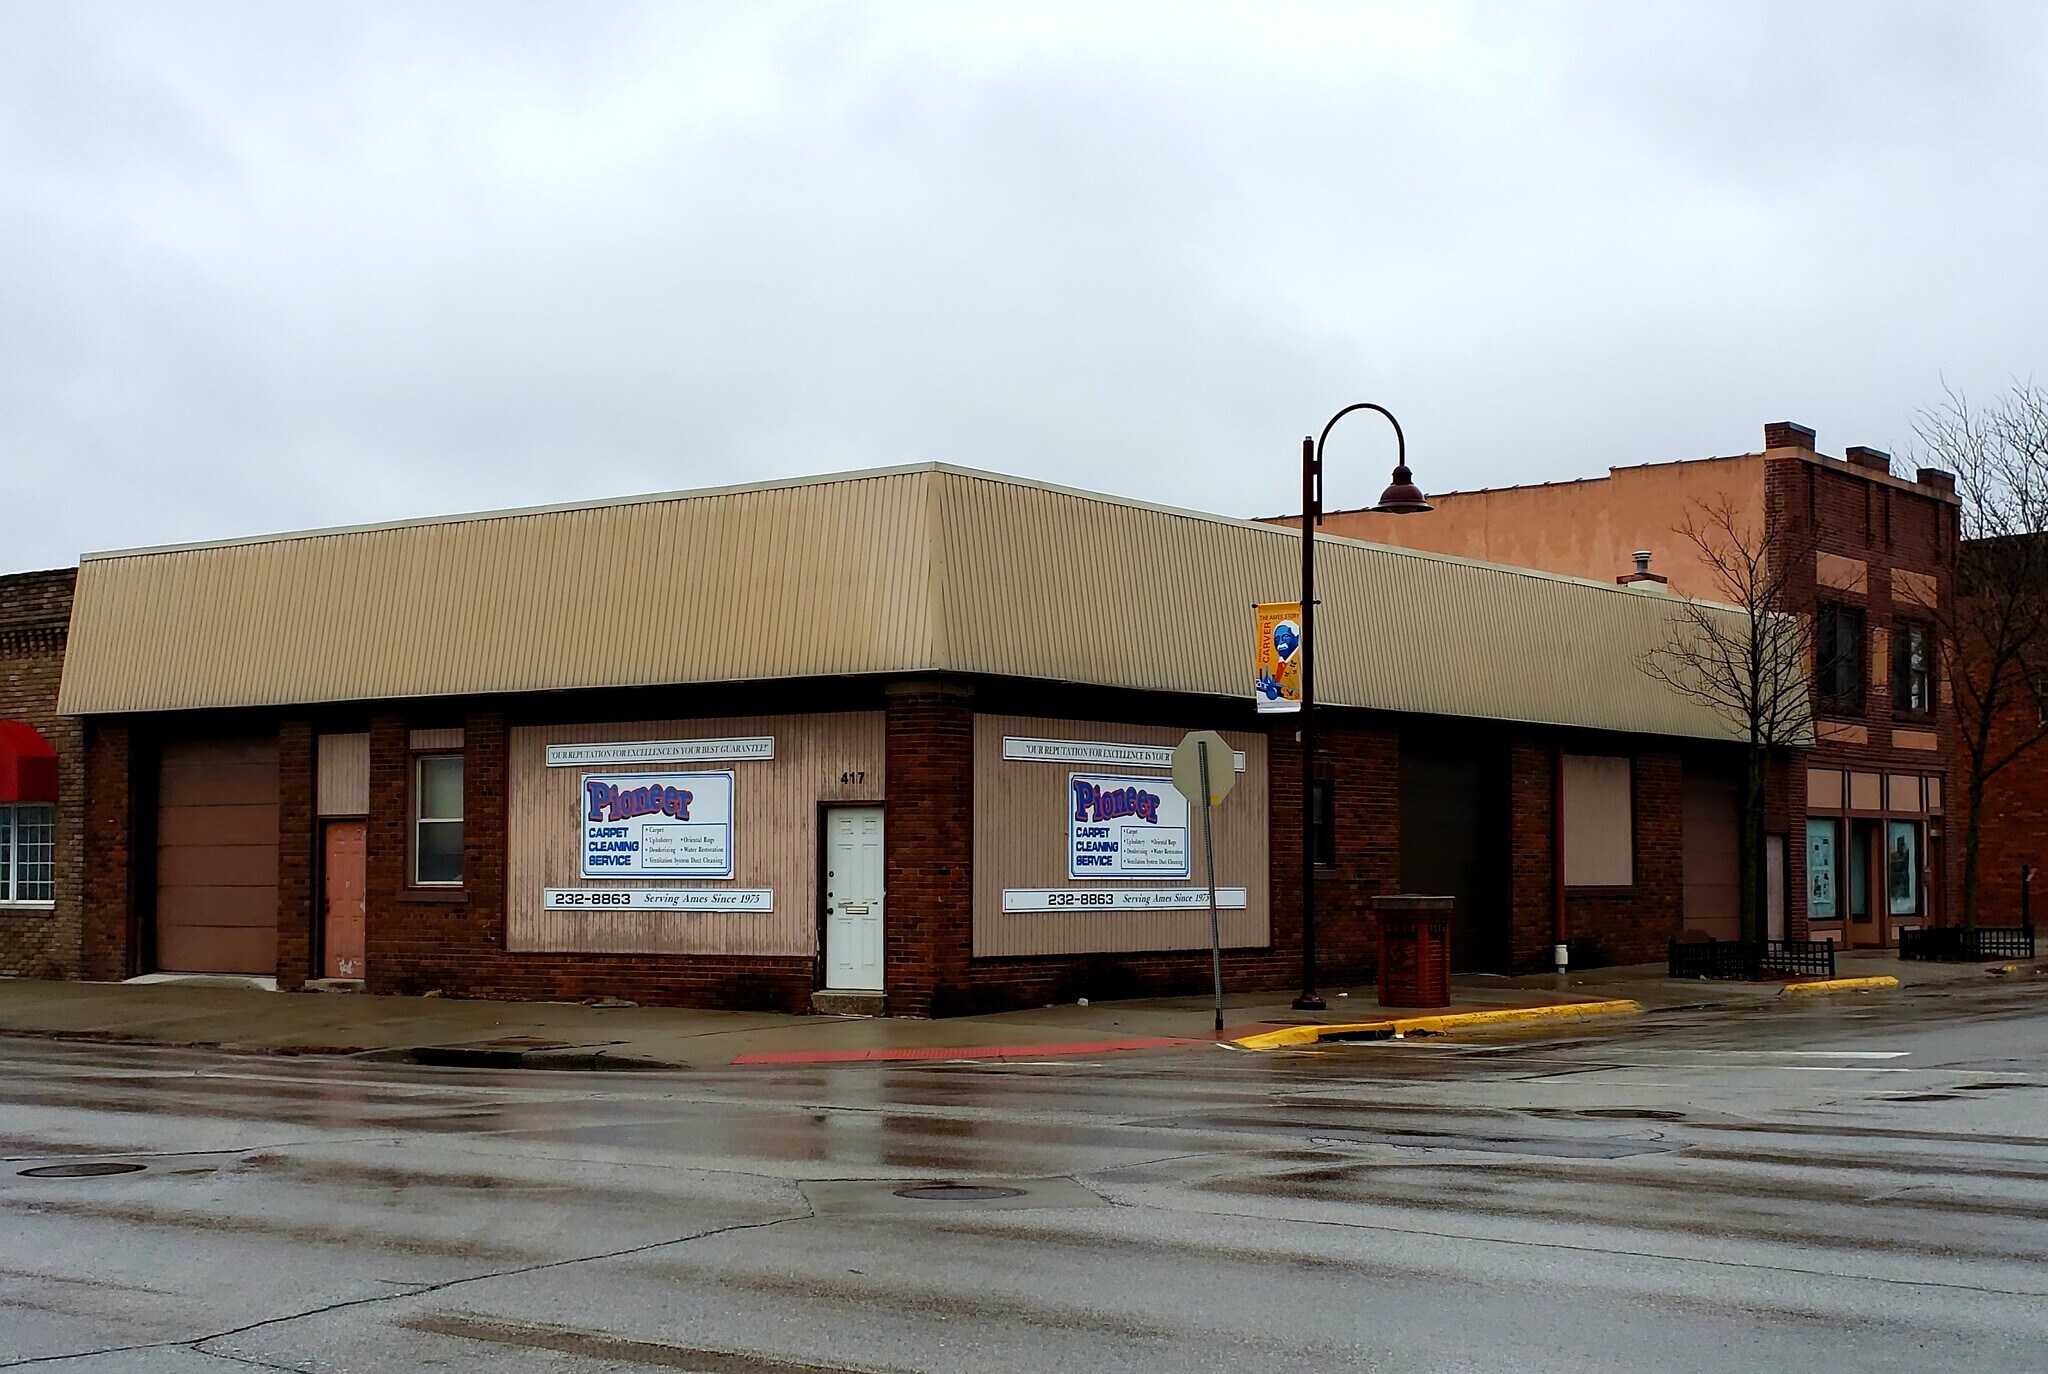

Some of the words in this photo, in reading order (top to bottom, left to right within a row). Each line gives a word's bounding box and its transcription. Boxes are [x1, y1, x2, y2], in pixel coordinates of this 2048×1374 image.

[1263, 622, 1271, 663] CARVER
[568, 750, 612, 759] REPUTATION
[613, 749, 626, 757] FOR
[627, 747, 672, 757] EXCELLENCE
[673, 747, 680, 755] IS
[680, 746, 700, 755] YOUR
[702, 746, 720, 754] BEST
[1044, 746, 1089, 756] REPUTATION
[1090, 748, 1102, 757] FOR
[1103, 748, 1142, 760] EXCELLENCE
[1145, 752, 1151, 760] IS
[1152, 752, 1170, 761] YOUR
[841, 772, 864, 784] 417
[587, 781, 694, 822] Pioneer
[1074, 780, 1160, 824] Pioneer
[588, 827, 629, 838] CARPET
[1076, 827, 1110, 838] CARPET
[1126, 828, 1138, 836] Carpet
[588, 841, 639, 852] CLEANING
[649, 846, 676, 854] Deodorizing
[1076, 841, 1118, 852] CLEANING
[588, 855, 631, 866] SERVICE
[674, 857, 689, 865] System
[703, 857, 723, 865] Cleaning
[1076, 856, 1112, 866] SERVICE
[556, 894, 631, 904] 232-8863
[644, 894, 680, 906] Serving
[682, 894, 708, 903] Ames
[711, 894, 736, 903] Since
[740, 894, 760, 903] 1975
[1048, 894, 1114, 905] 232-8863
[1123, 893, 1151, 906] Serving
[1153, 894, 1172, 903] Ames
[1174, 893, 1193, 902] Since
[1195, 893, 1210, 902] 1975
